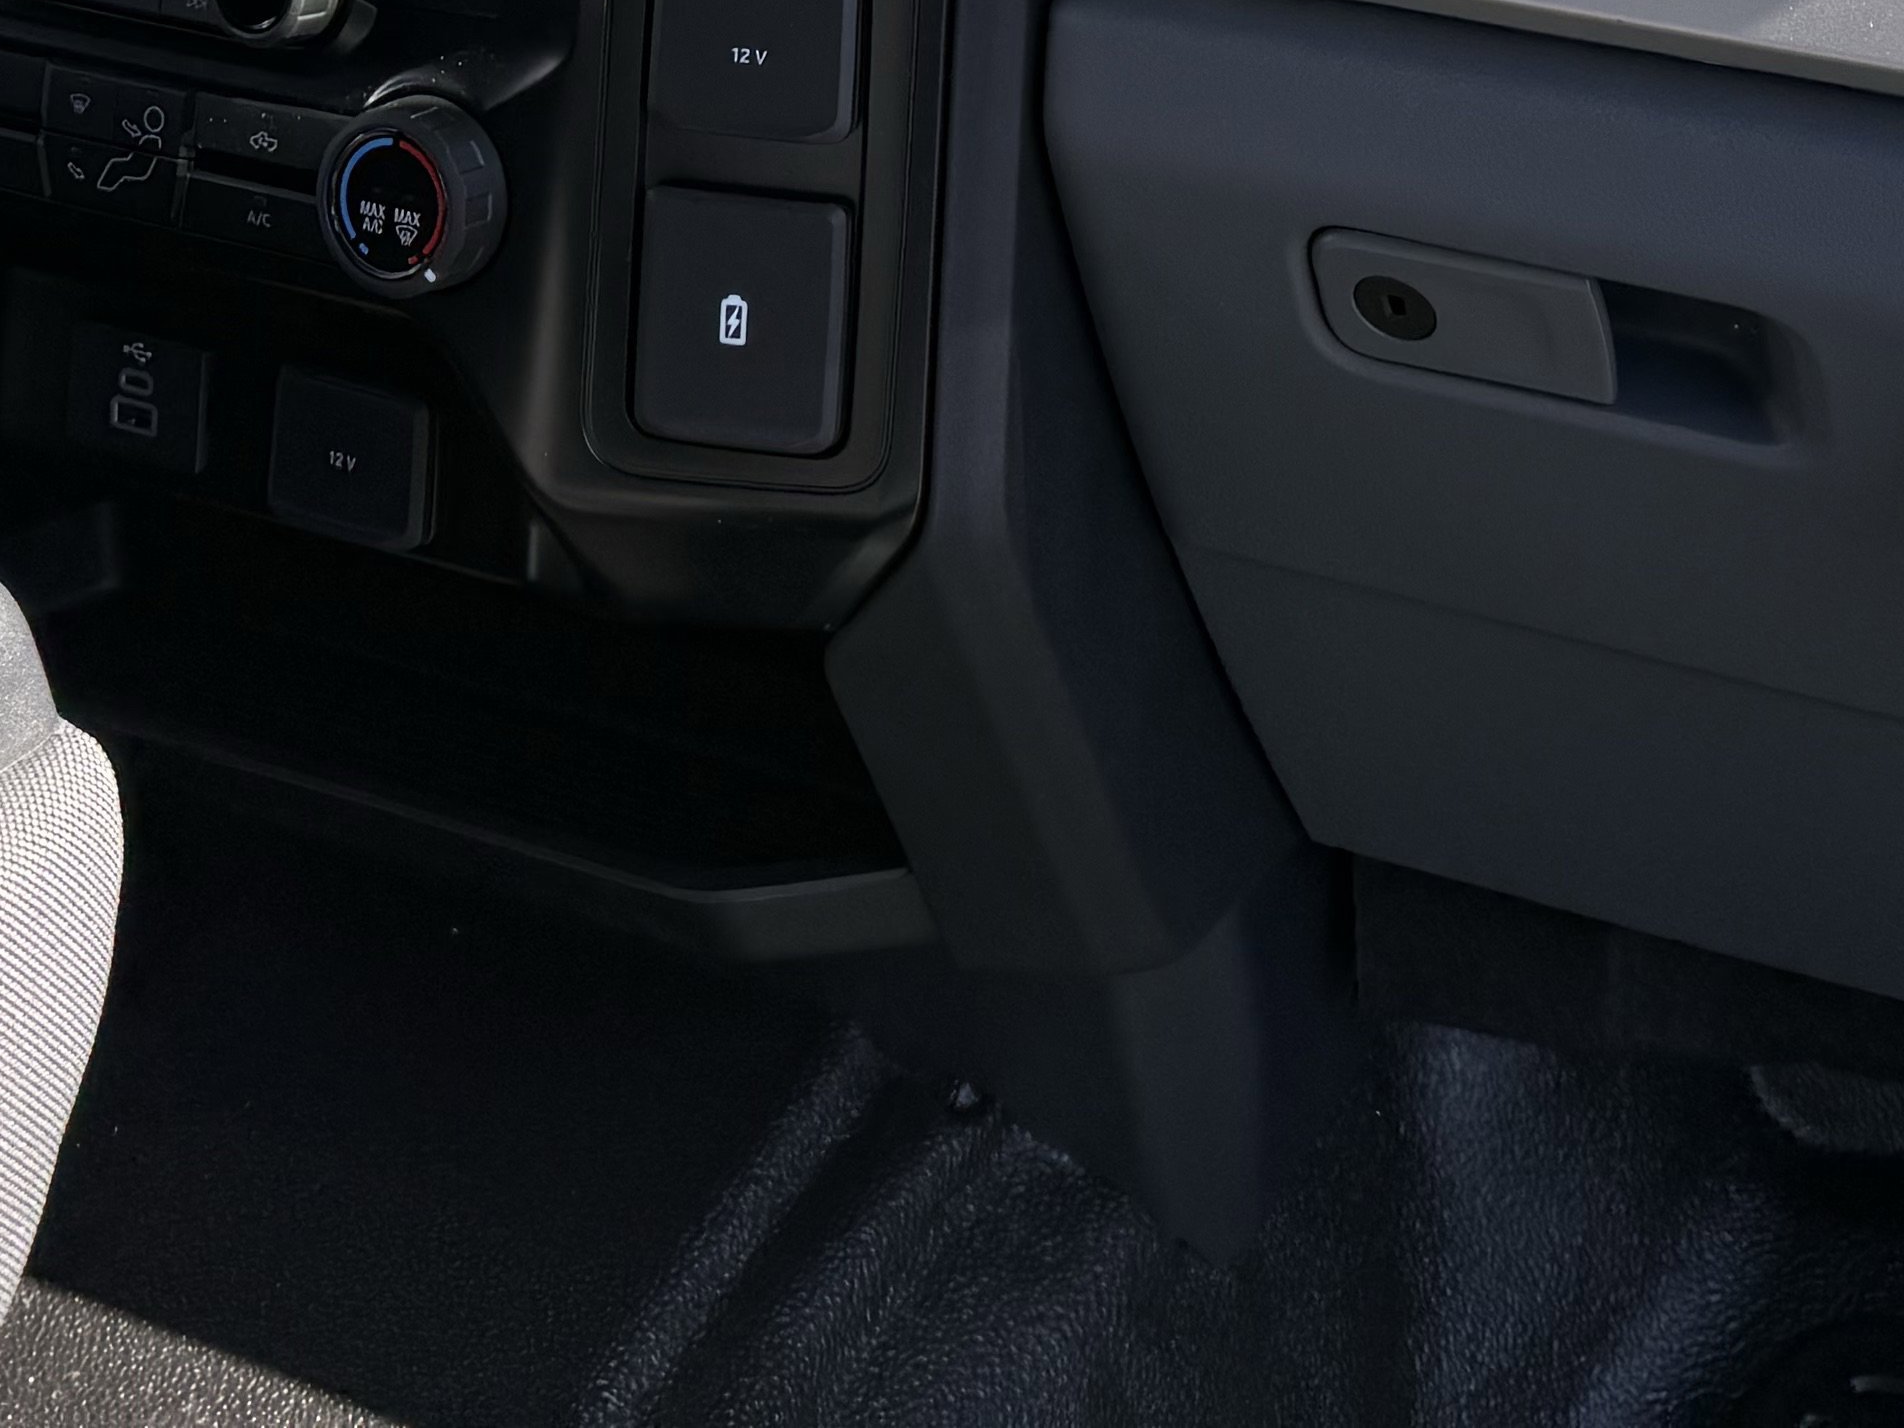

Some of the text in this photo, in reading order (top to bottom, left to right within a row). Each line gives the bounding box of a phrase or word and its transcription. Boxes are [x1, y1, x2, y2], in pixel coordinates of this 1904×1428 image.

[731, 47, 768, 65] 12 V
[246, 209, 272, 228] A/C
[359, 200, 386, 220] MAX
[394, 207, 421, 227] MAX
[329, 449, 357, 473] 12 V
